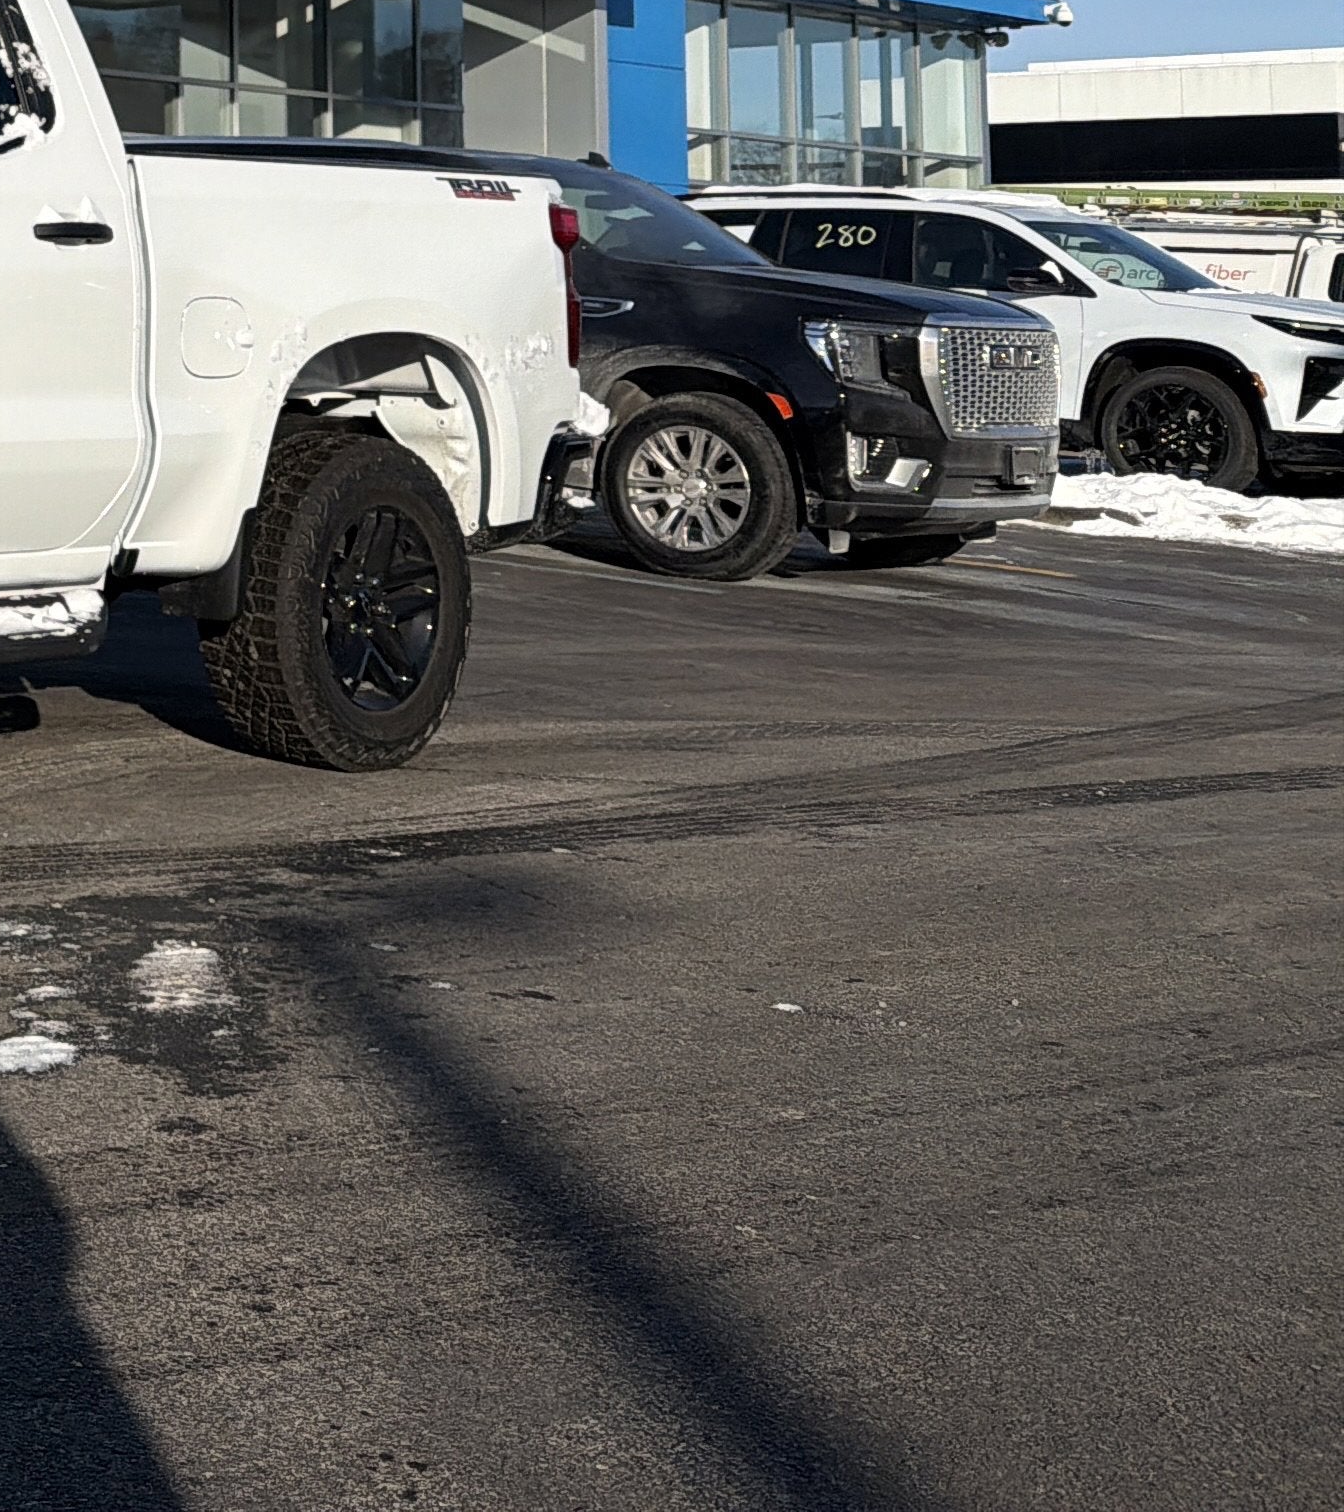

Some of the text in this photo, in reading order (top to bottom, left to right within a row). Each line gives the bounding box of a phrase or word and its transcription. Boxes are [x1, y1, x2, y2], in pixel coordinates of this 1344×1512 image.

[435, 176, 522, 193] TRAIL
[814, 223, 877, 248] 280
[1204, 263, 1252, 281] fiber
